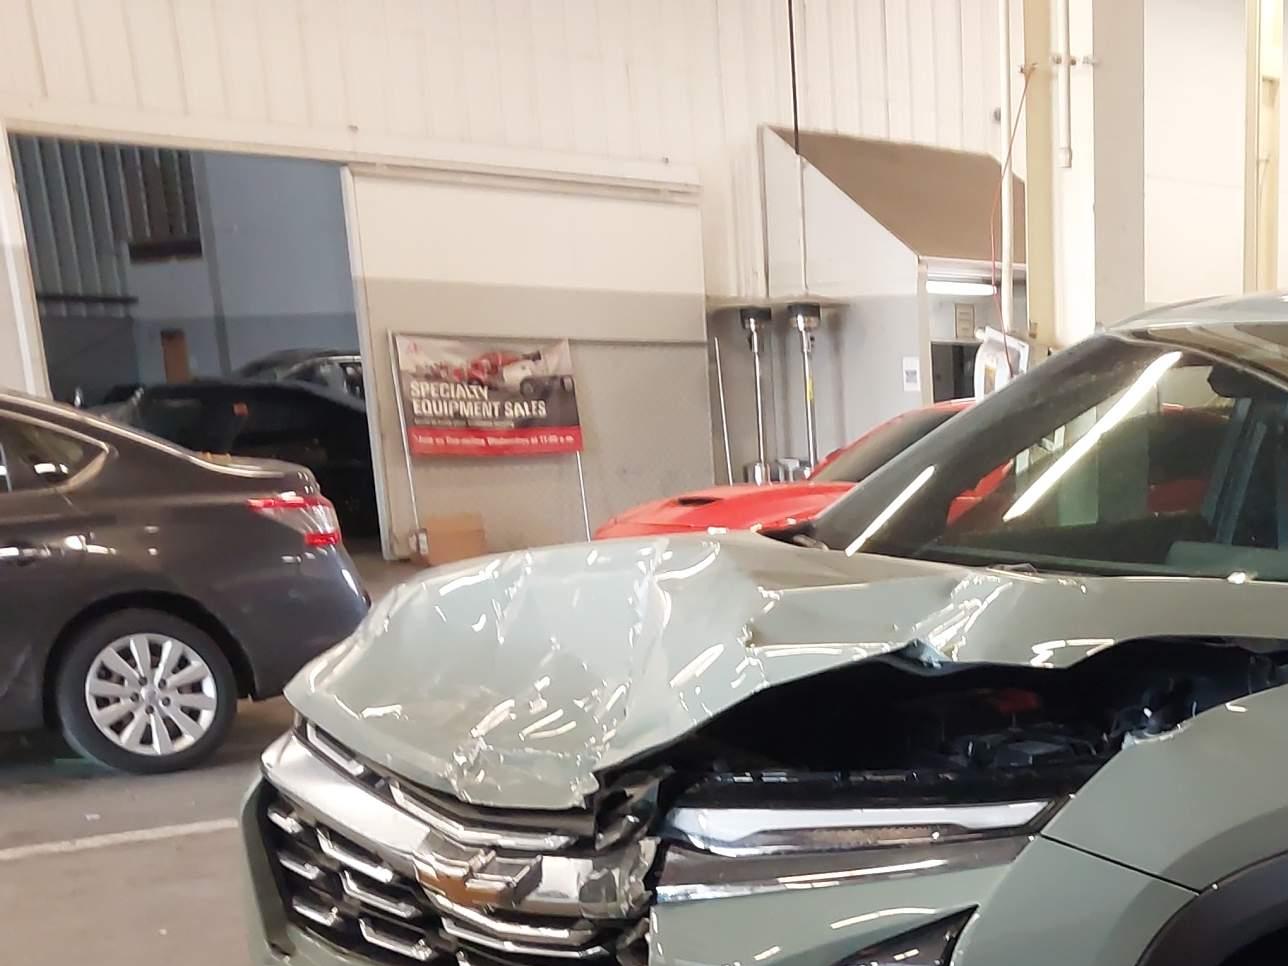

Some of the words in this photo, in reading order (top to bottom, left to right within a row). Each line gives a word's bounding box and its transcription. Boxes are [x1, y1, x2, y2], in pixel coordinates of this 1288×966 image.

[410, 381, 489, 400] SPECIALTY
[412, 399, 500, 418] EQUIPMENT
[503, 400, 547, 418] SALES
